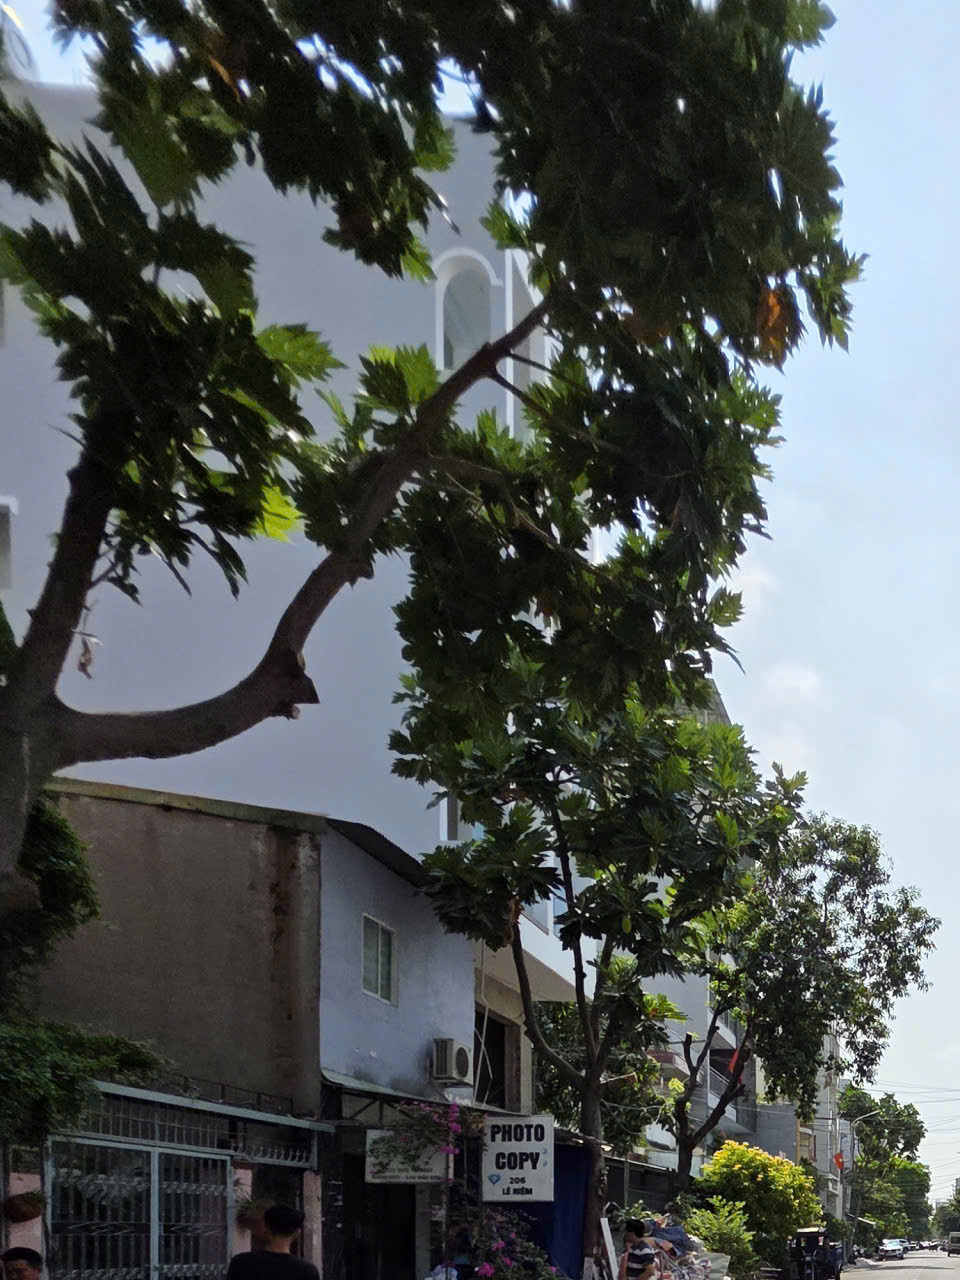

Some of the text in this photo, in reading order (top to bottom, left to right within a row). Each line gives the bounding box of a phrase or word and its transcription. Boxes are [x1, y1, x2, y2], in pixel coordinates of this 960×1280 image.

[490, 1123, 545, 1143] PHOTO
[495, 1151, 540, 1171] COPY
[509, 1176, 526, 1185] 206
